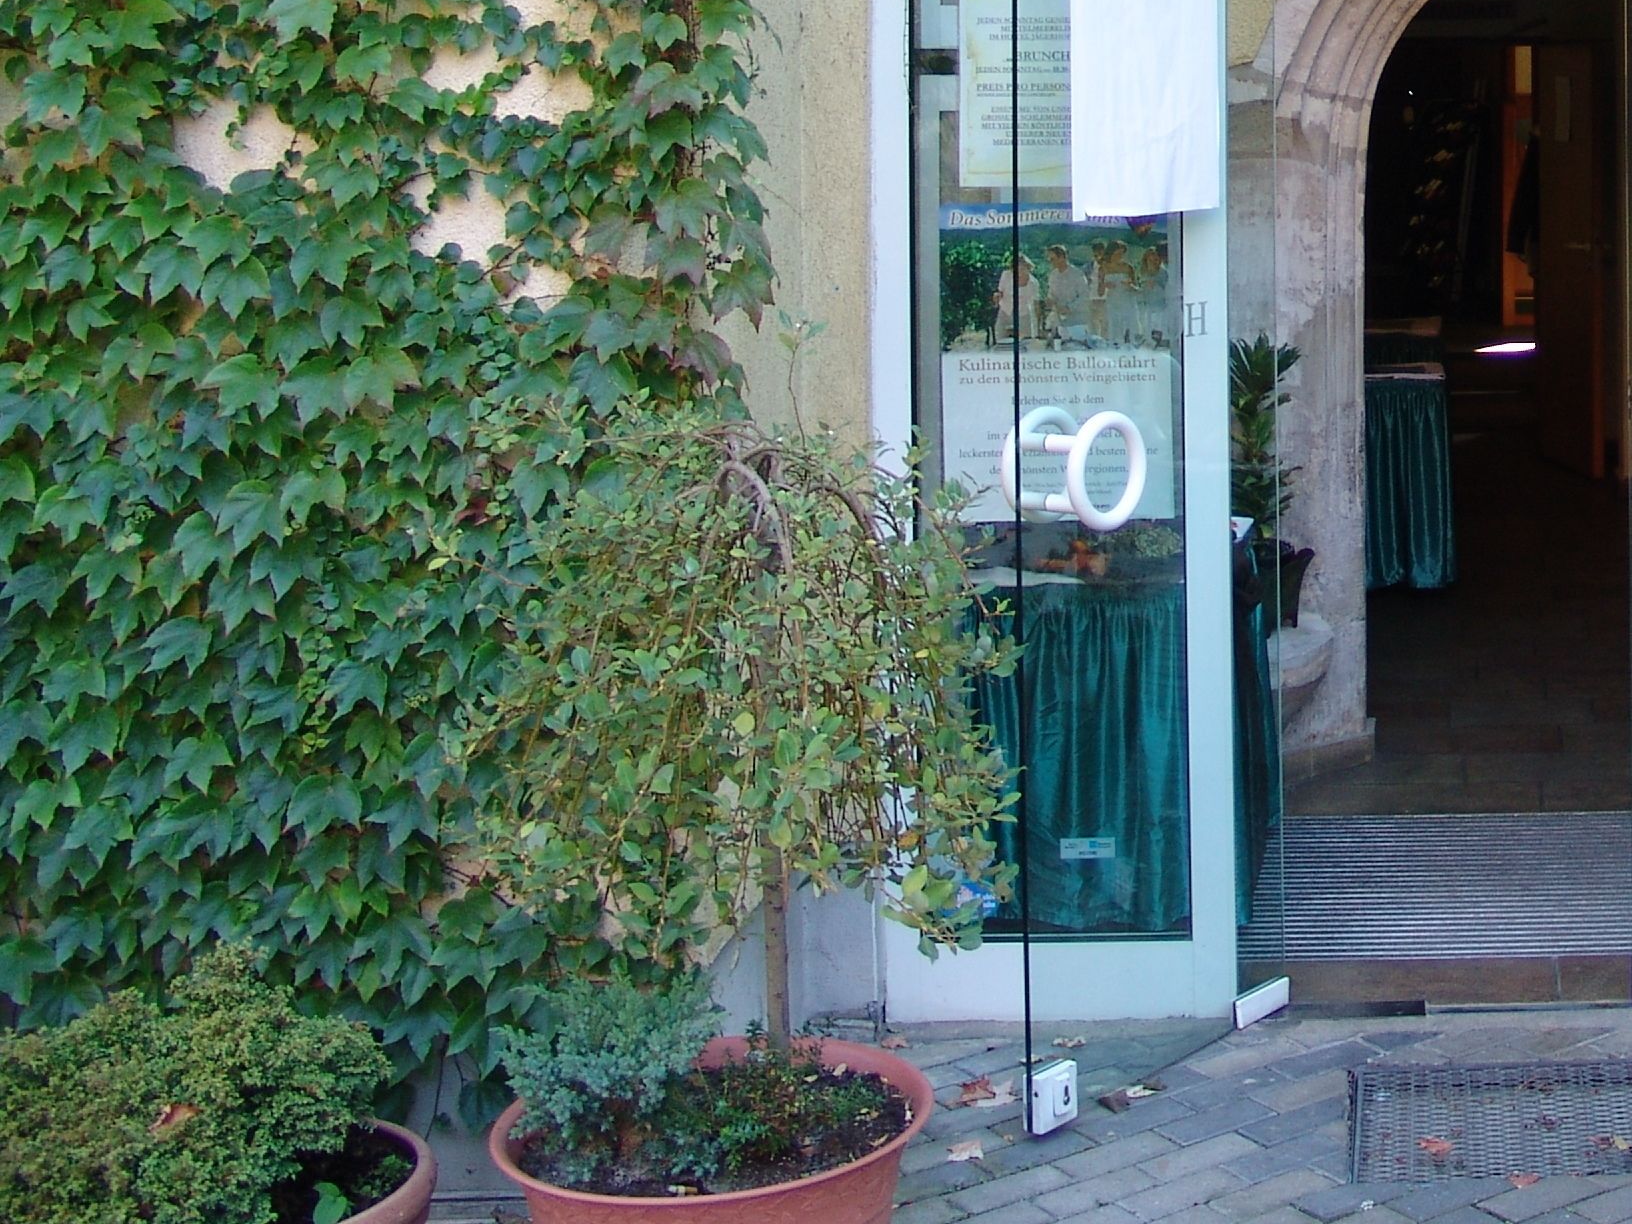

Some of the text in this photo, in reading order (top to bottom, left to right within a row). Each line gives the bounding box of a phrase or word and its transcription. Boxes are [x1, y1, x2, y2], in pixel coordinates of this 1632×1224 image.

[976, 82, 1004, 91] PREIS
[949, 210, 982, 226] Das
[1067, 356, 1156, 370] Ballonfahrt
[959, 375, 973, 385] zu
[977, 374, 1000, 384] den
[1072, 372, 1156, 385] Weingebieten
[1069, 394, 1081, 404] ab
[1083, 394, 1104, 404] dem
[1095, 447, 1126, 457] besten
